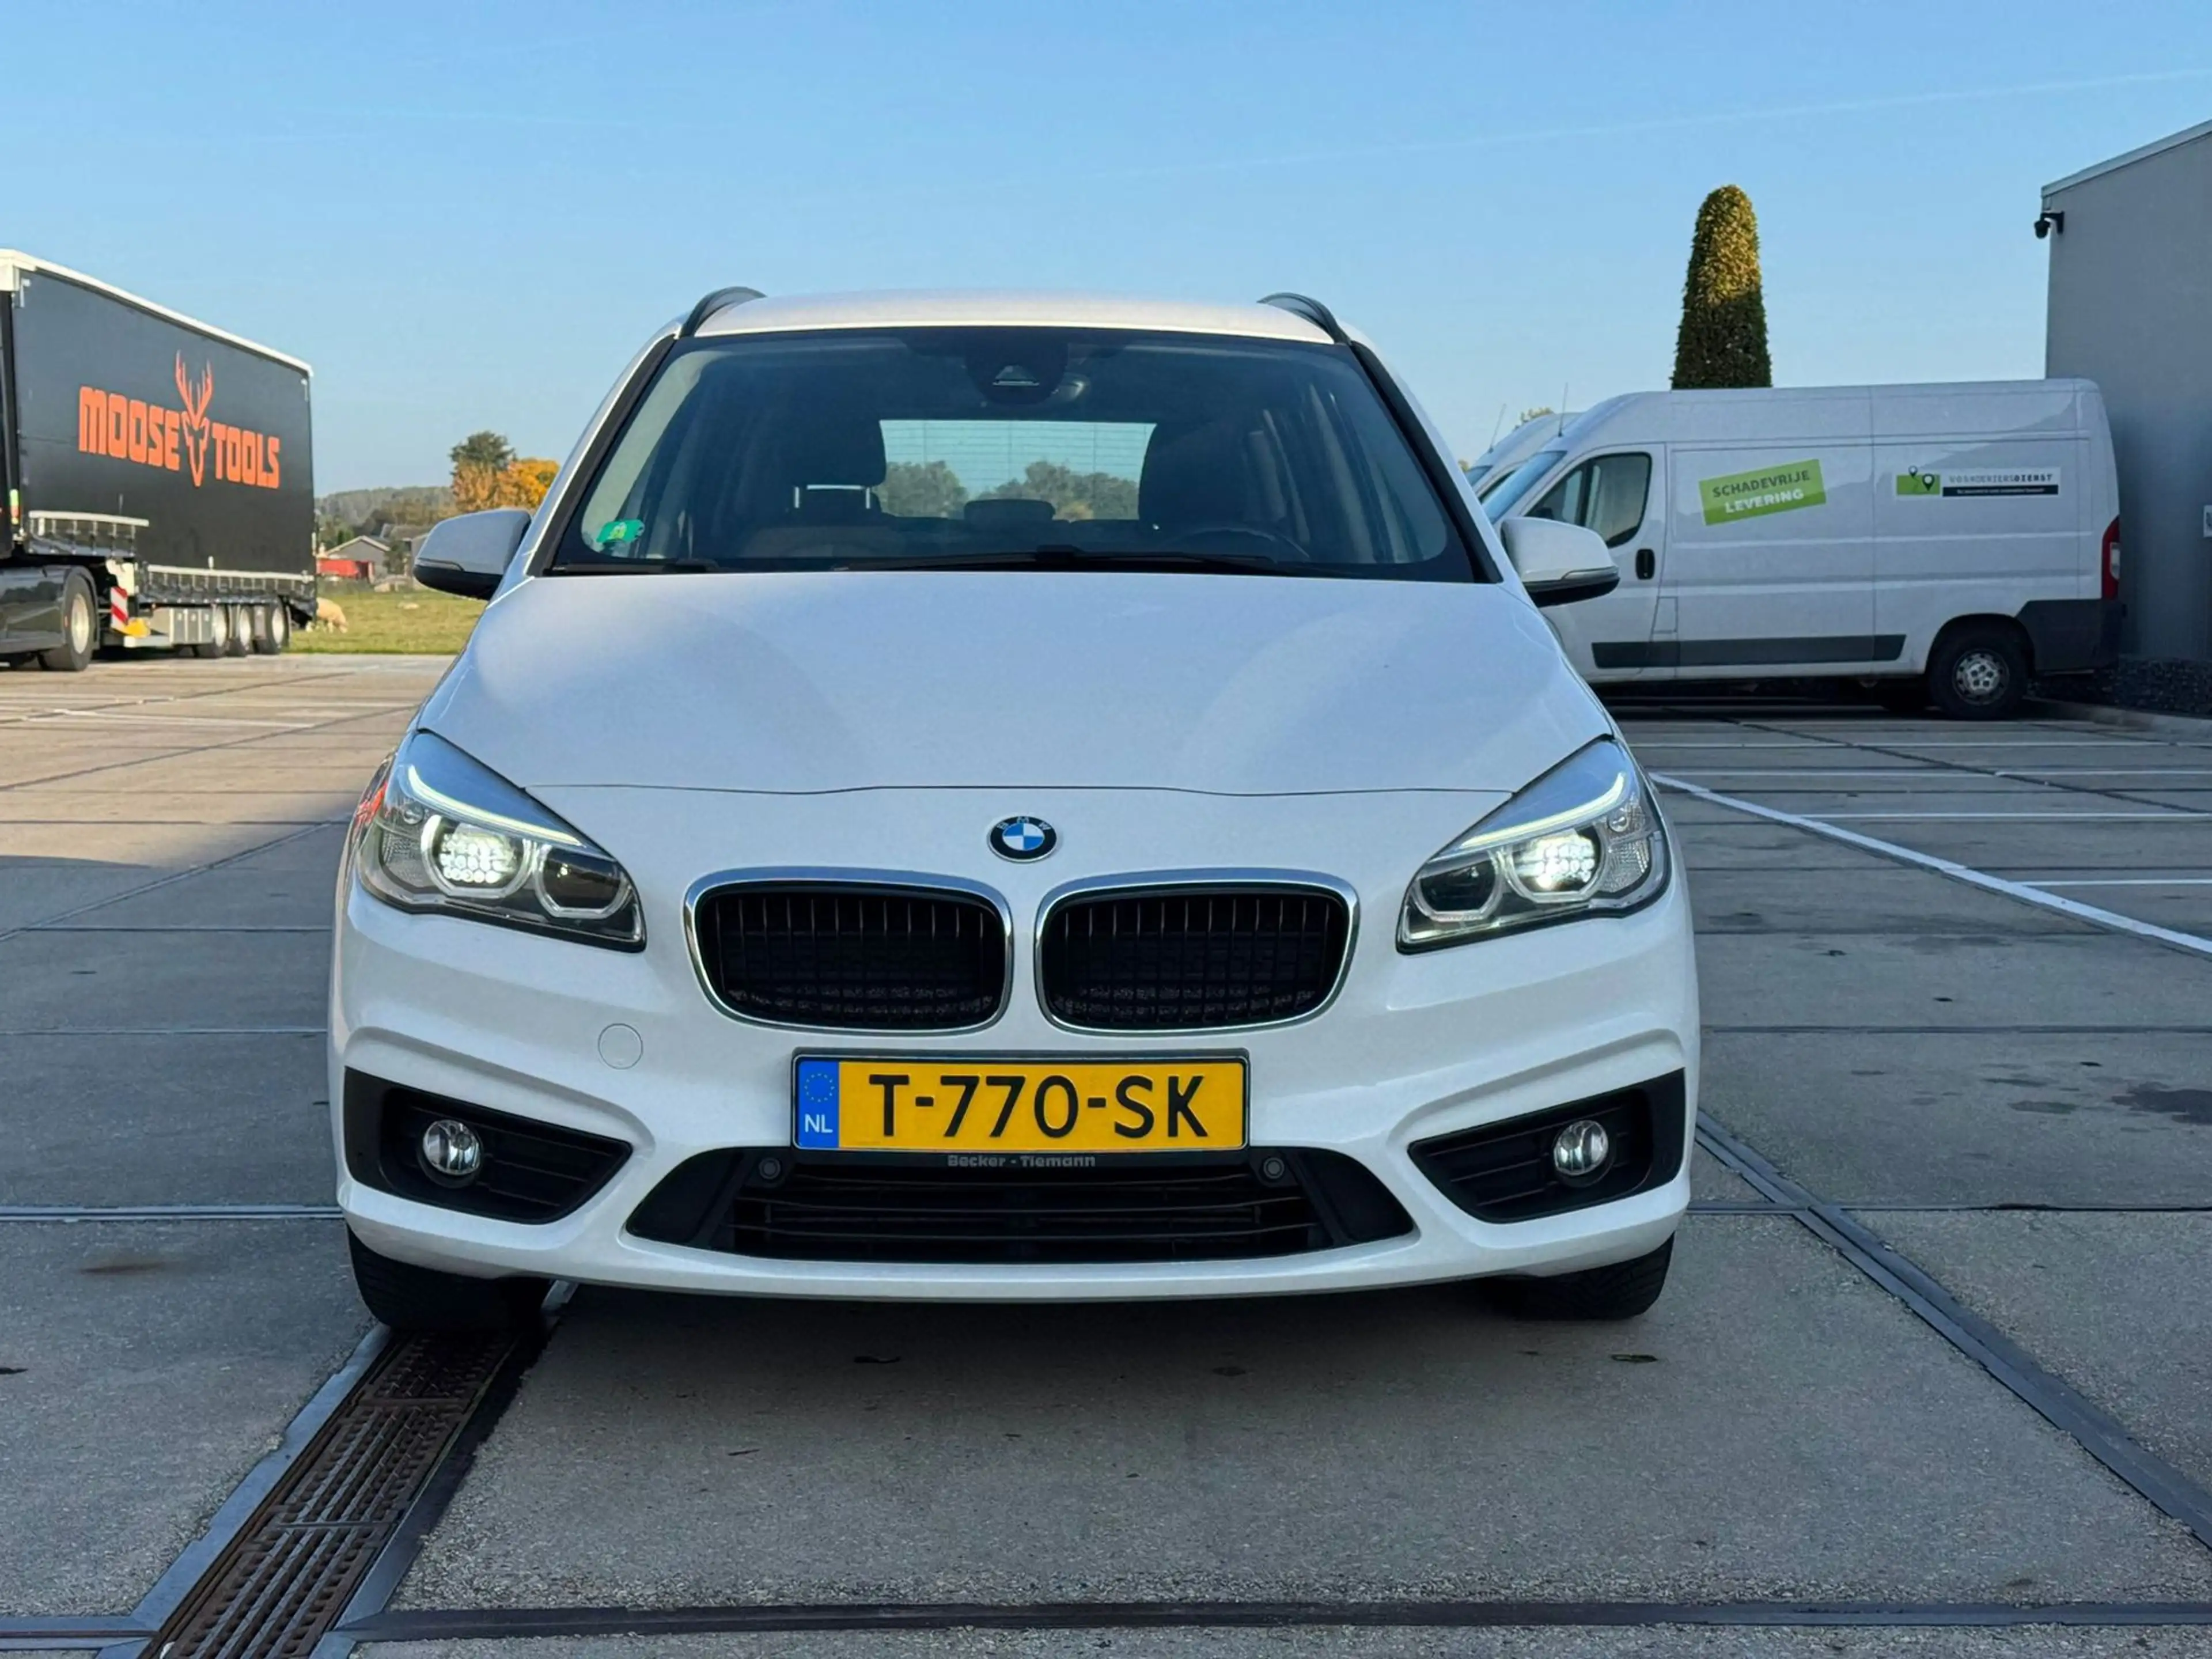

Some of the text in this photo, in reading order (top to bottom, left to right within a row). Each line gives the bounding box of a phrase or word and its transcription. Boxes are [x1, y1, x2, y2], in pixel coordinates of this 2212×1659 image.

[79, 386, 279, 488] MOOSE TOOLS
[1712, 469, 1810, 498] SCHADEVRIJE
[1725, 488, 1804, 513] LEVERING
[997, 816, 1051, 831] BMW
[805, 1074, 1209, 1138] NL T-770-SK
[948, 1155, 1006, 1167] Becker
[1020, 1156, 1096, 1168] Tiemann
